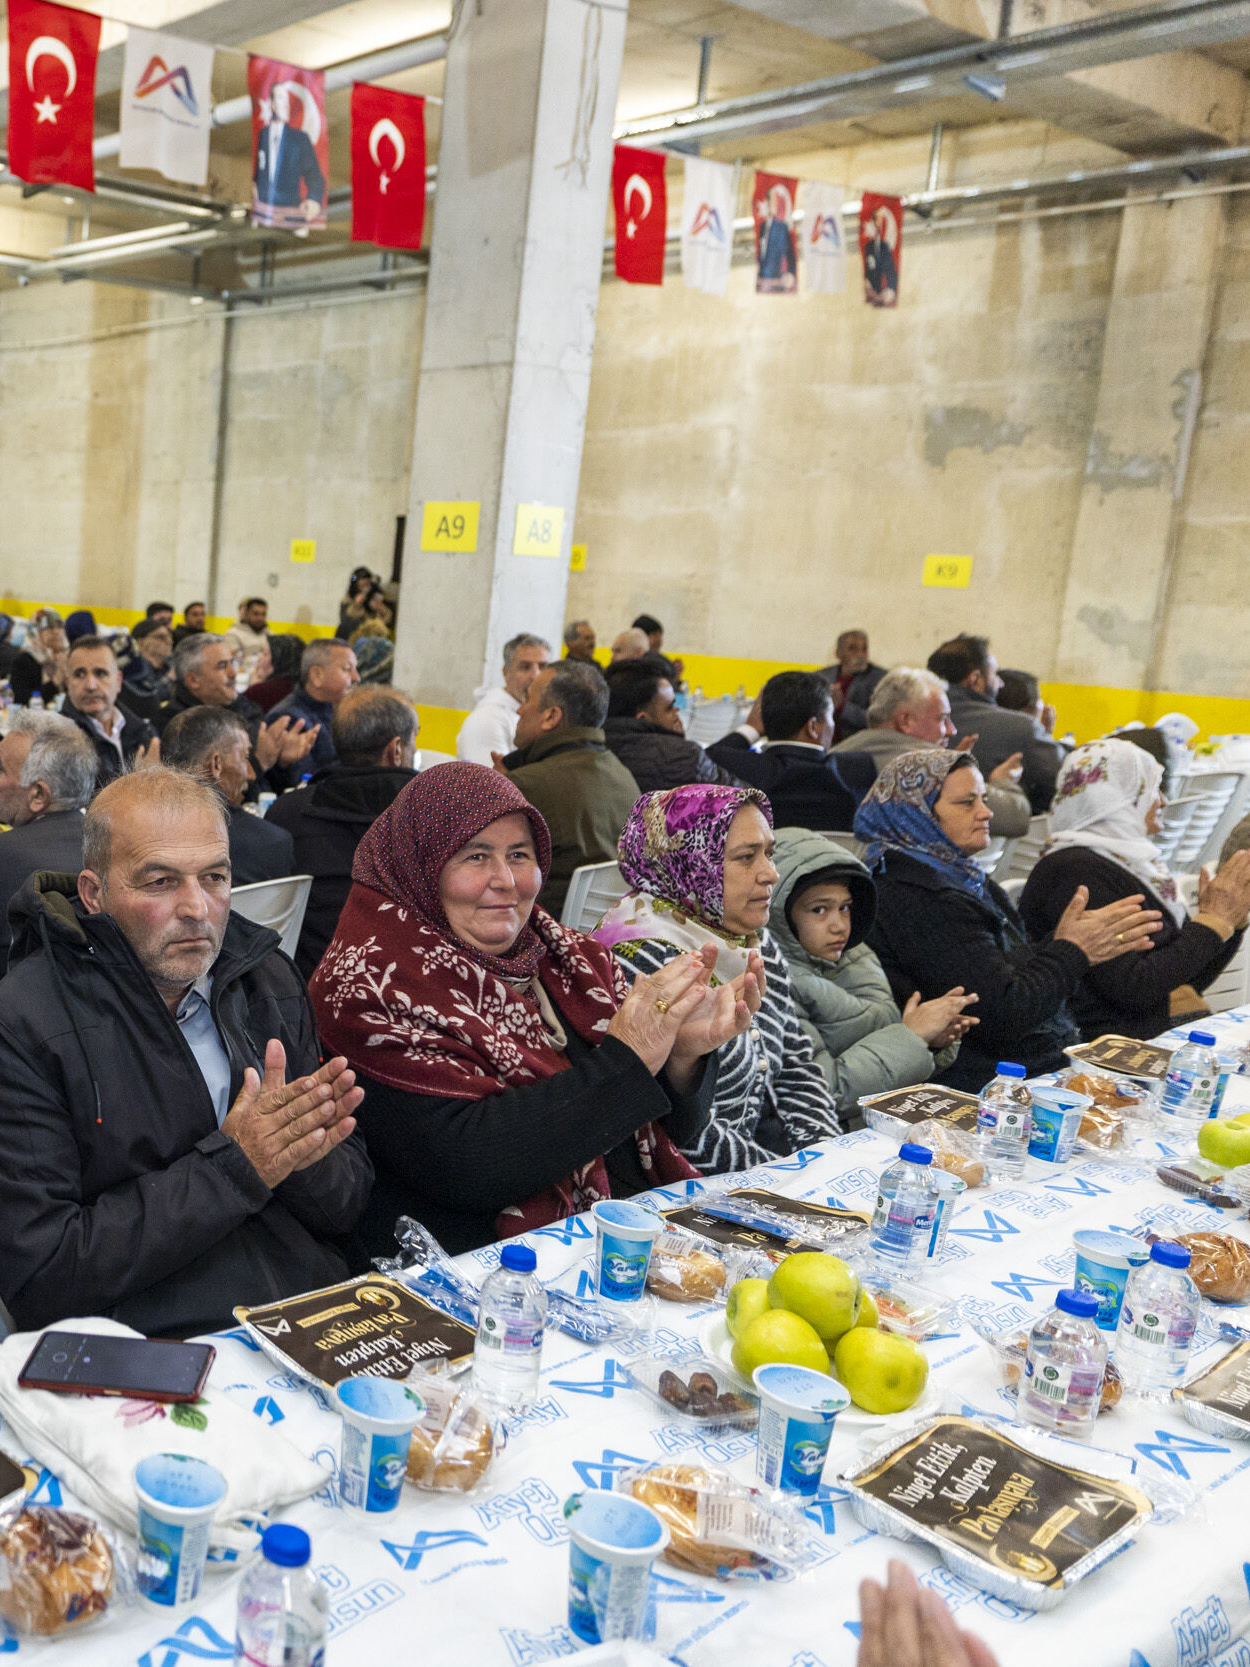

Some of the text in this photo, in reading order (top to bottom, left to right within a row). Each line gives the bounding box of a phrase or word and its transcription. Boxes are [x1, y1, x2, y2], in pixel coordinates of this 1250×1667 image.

[435, 514, 466, 540] A9
[526, 519, 553, 544] A8
[935, 563, 959, 579] K9
[829, 1167, 879, 1194] Olsun
[608, 1259, 641, 1273] Varol
[333, 1334, 400, 1368] Kalpten
[400, 1336, 452, 1366] Niyet
[888, 1471, 937, 1508] Niyet
[939, 1455, 998, 1505] Kalpten
[476, 1482, 555, 1524] Afiyet
[525, 1512, 570, 1541] Ols
